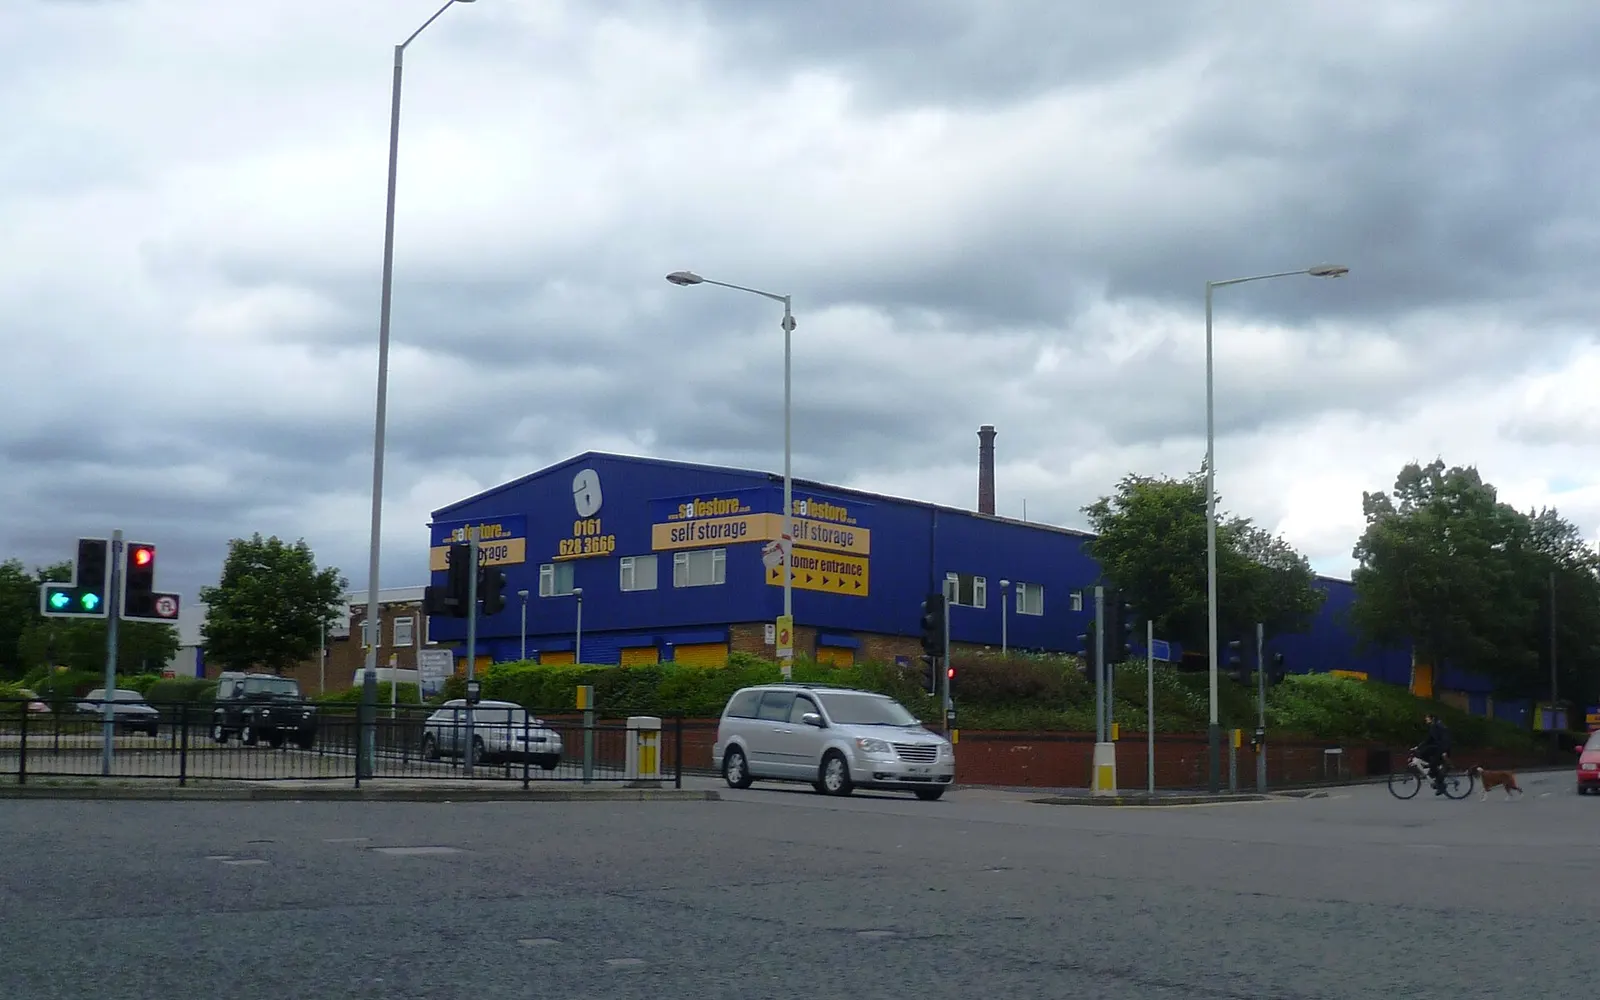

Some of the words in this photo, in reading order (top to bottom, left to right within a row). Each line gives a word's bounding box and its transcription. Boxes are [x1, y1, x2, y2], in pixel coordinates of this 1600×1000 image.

[679, 498, 739, 519] safestore
[574, 519, 601, 537] 0161
[671, 522, 696, 542] self
[698, 521, 747, 540] storage
[793, 520, 808, 539] elf
[811, 524, 854, 547] storage
[559, 539, 582, 555] 628
[584, 535, 615, 553] 3666
[821, 559, 863, 577] entrance
